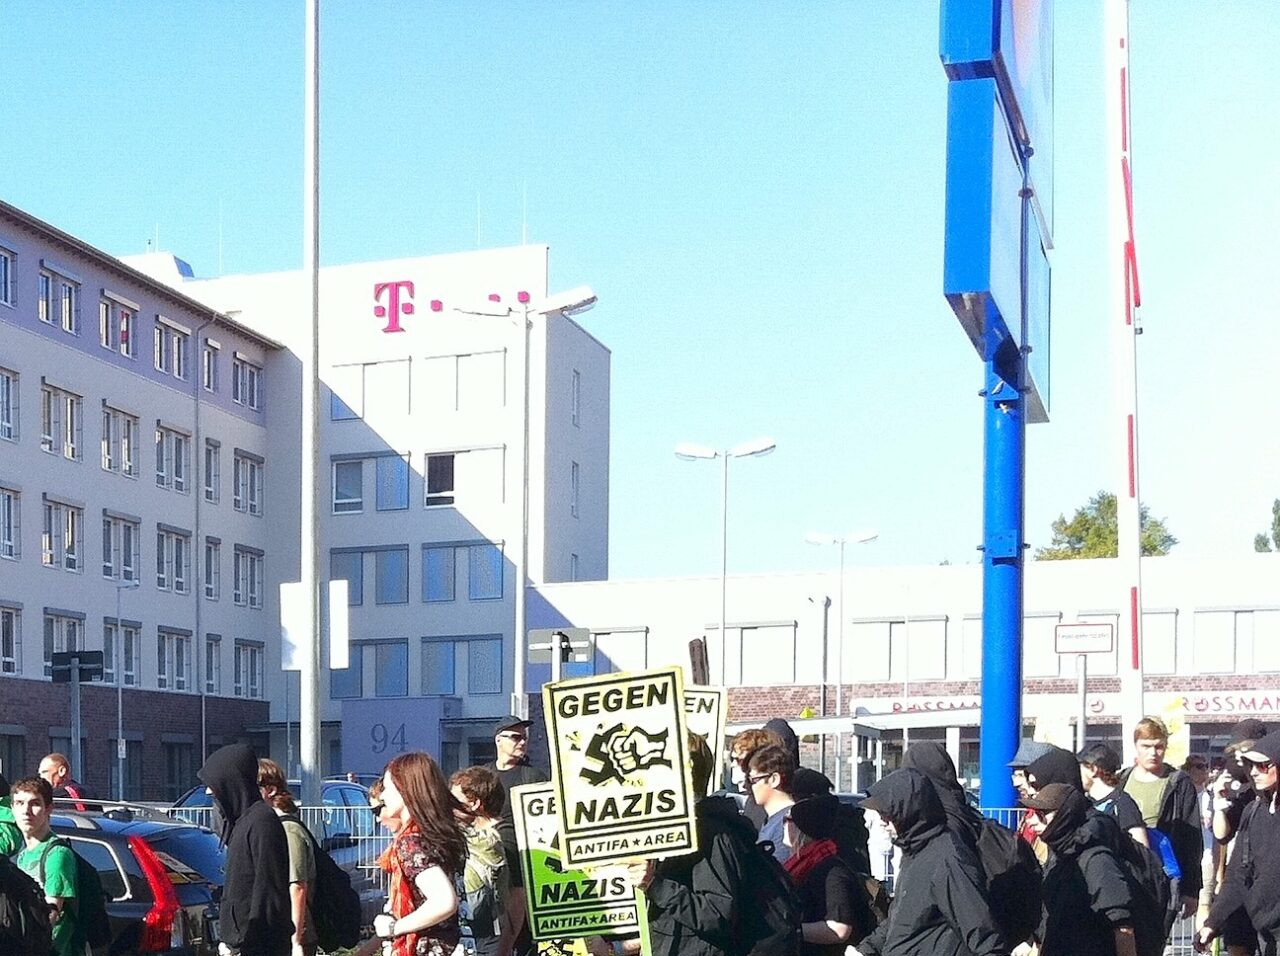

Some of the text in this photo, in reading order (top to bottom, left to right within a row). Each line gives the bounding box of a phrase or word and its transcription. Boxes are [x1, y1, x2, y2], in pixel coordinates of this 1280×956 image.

[374, 281, 414, 333] T
[558, 682, 669, 718] GEGEN
[371, 723, 408, 753] 94
[574, 789, 676, 825] NAZIS
[573, 831, 686, 856] ANTIFA AREA
[540, 877, 626, 905] NAZIS
[540, 911, 635, 931] ANTIFA AREA
